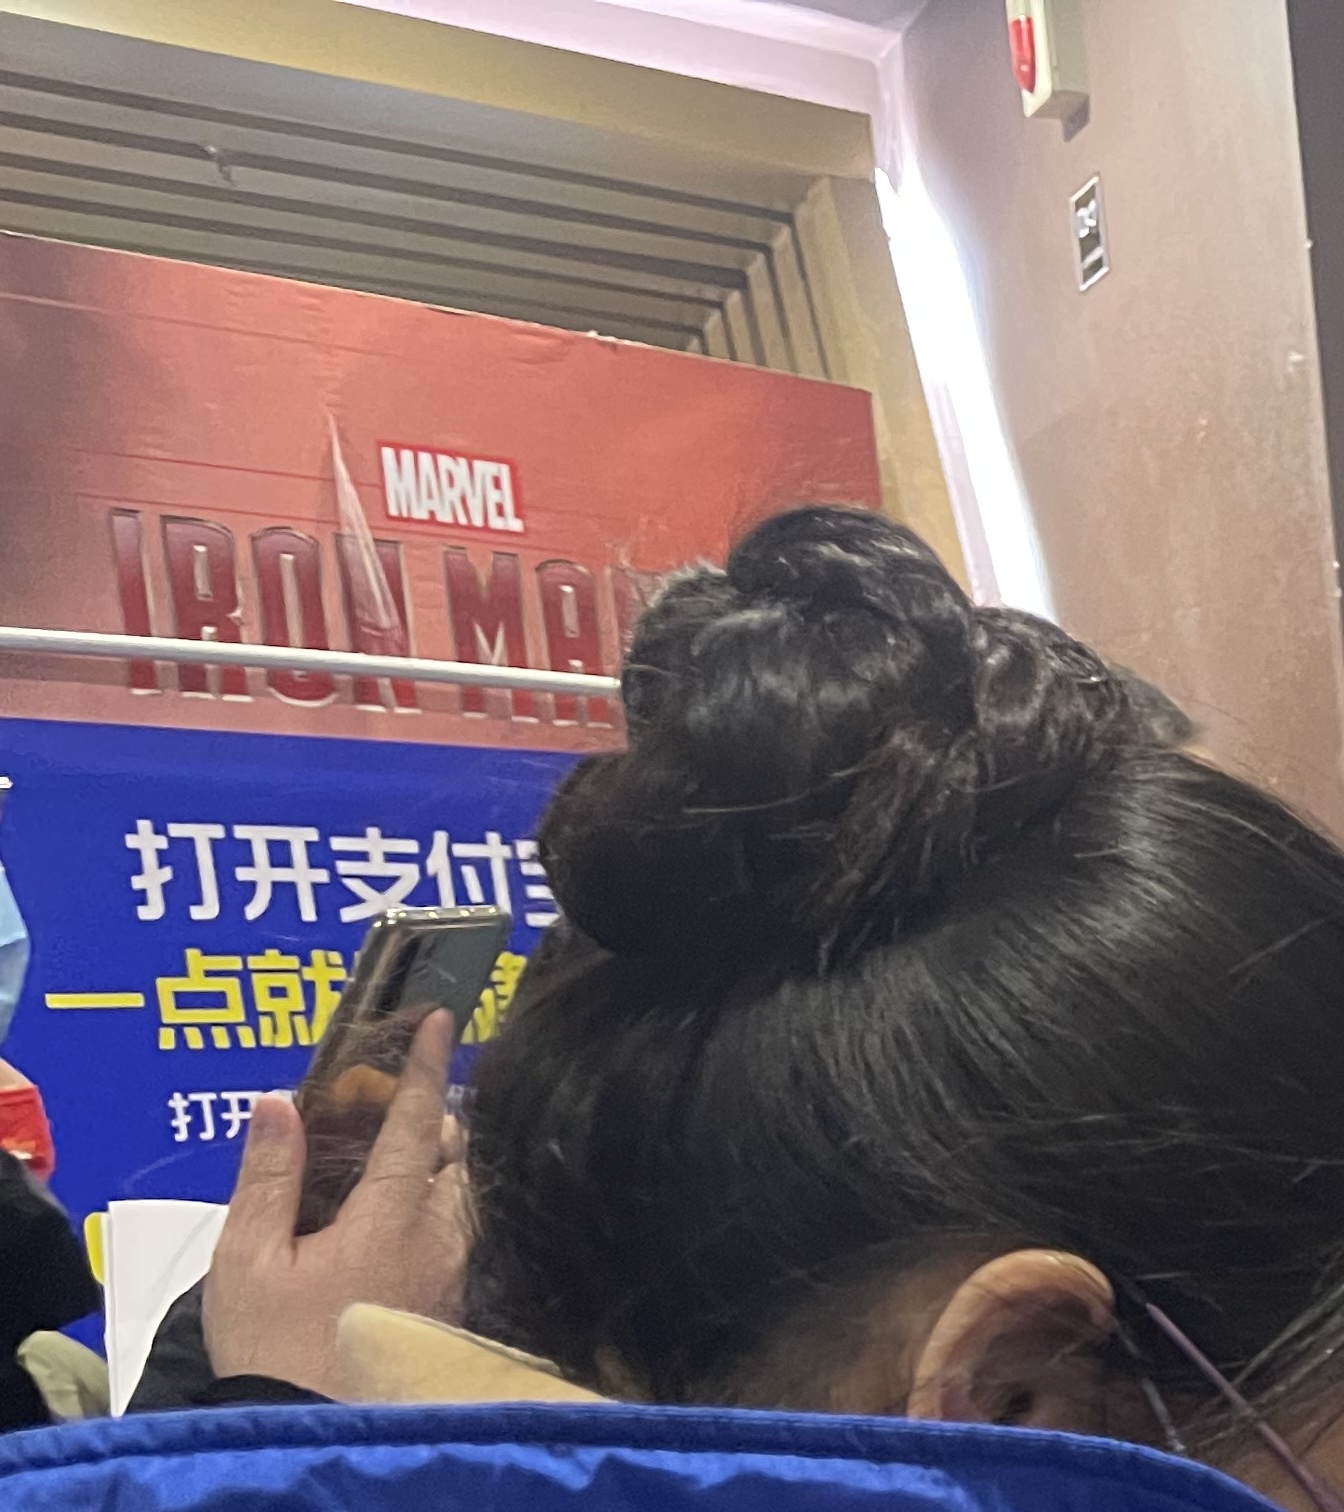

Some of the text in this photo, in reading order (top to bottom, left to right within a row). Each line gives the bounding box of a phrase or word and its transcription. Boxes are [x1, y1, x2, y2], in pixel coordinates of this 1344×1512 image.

[380, 445, 526, 533] MARVEL
[110, 508, 640, 730] IRON MA
